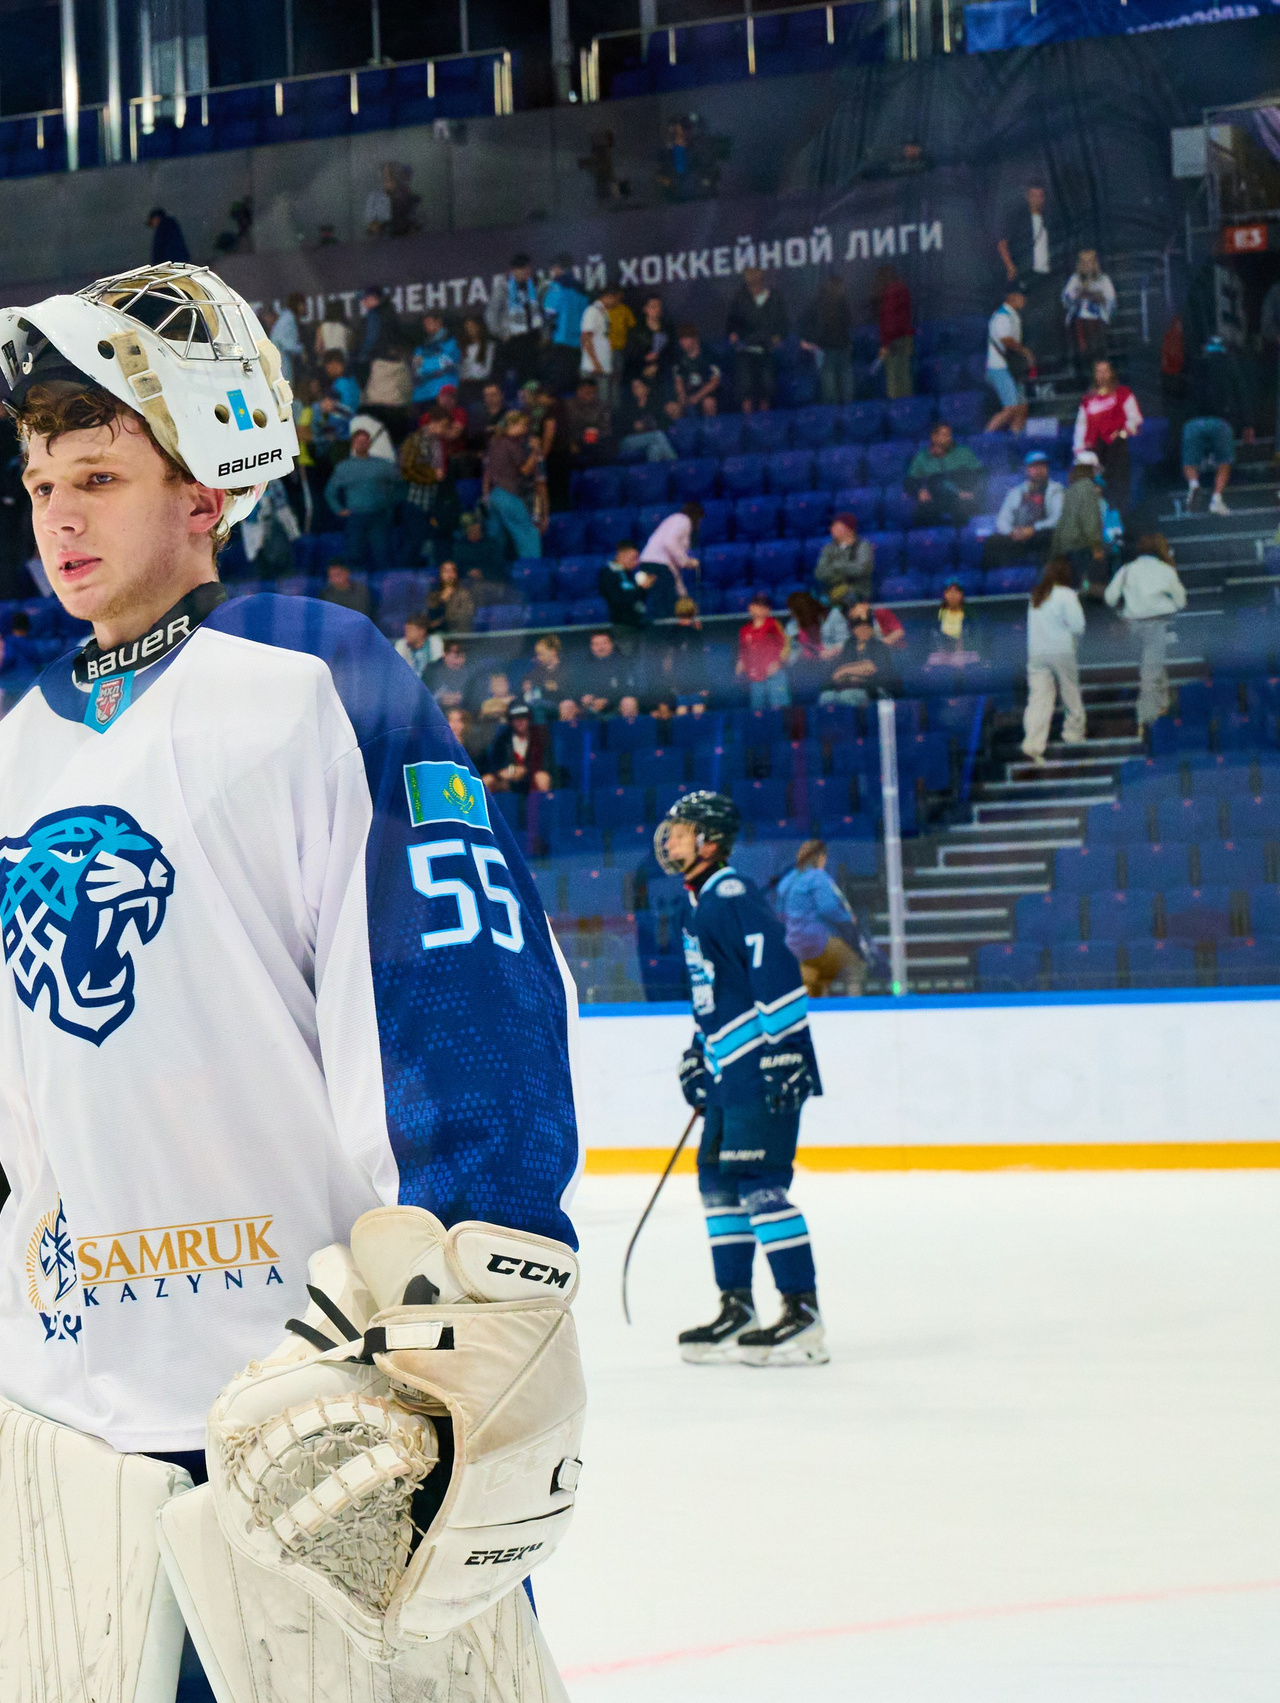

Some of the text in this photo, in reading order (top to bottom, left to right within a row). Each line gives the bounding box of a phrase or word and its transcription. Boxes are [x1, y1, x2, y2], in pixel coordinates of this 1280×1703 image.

[619, 226, 833, 286] ХОККЕЙНОЙ
[845, 220, 944, 261] ЛИГИ
[407, 838, 525, 953] 55
[745, 932, 764, 968] 7
[77, 1220, 280, 1281] SAMRUK
[487, 1253, 571, 1289] CCM
[83, 1265, 284, 1307] KAZYNA
